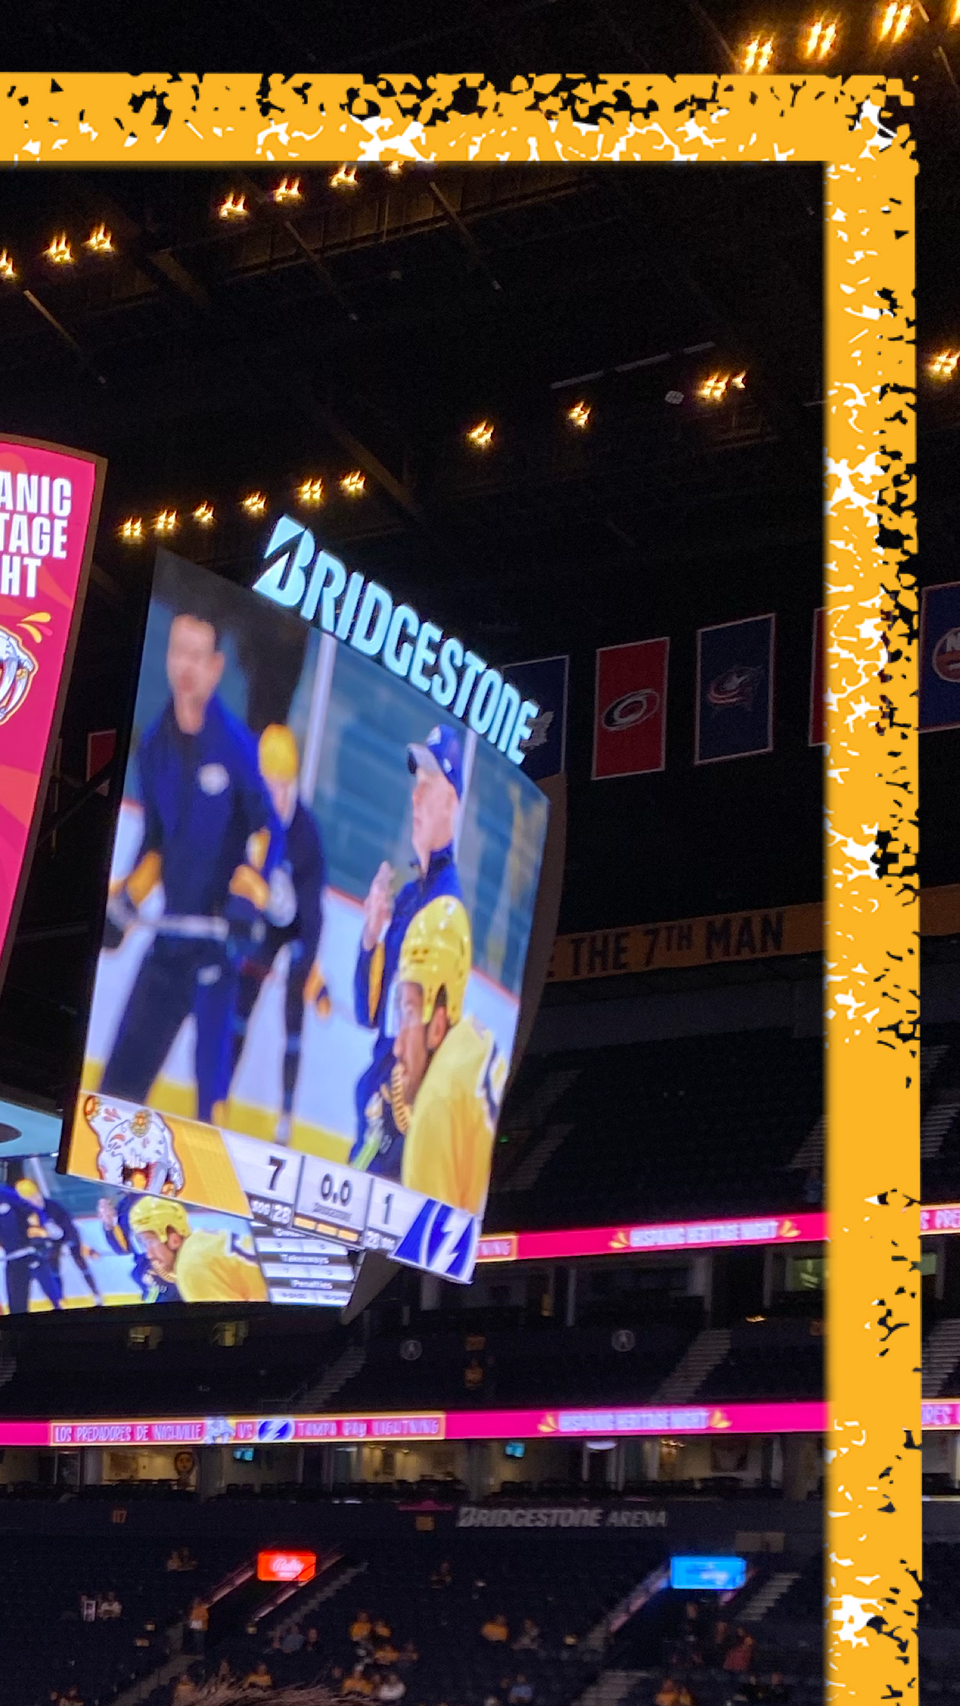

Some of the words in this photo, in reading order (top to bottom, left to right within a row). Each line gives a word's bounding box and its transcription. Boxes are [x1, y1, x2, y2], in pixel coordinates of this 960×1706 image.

[252, 514, 539, 765] BRIDGESTONE
[570, 932, 630, 976] THE
[706, 911, 785, 960] MAN
[269, 1155, 287, 1191] 7
[321, 1173, 353, 1206] 0.0
[383, 1193, 394, 1225] 1
[55, 1426, 71, 1441] LOS
[135, 1425, 149, 1440] DE
[455, 1506, 602, 1528] BRIDGESTONE
[606, 1510, 667, 1528] ARENA
